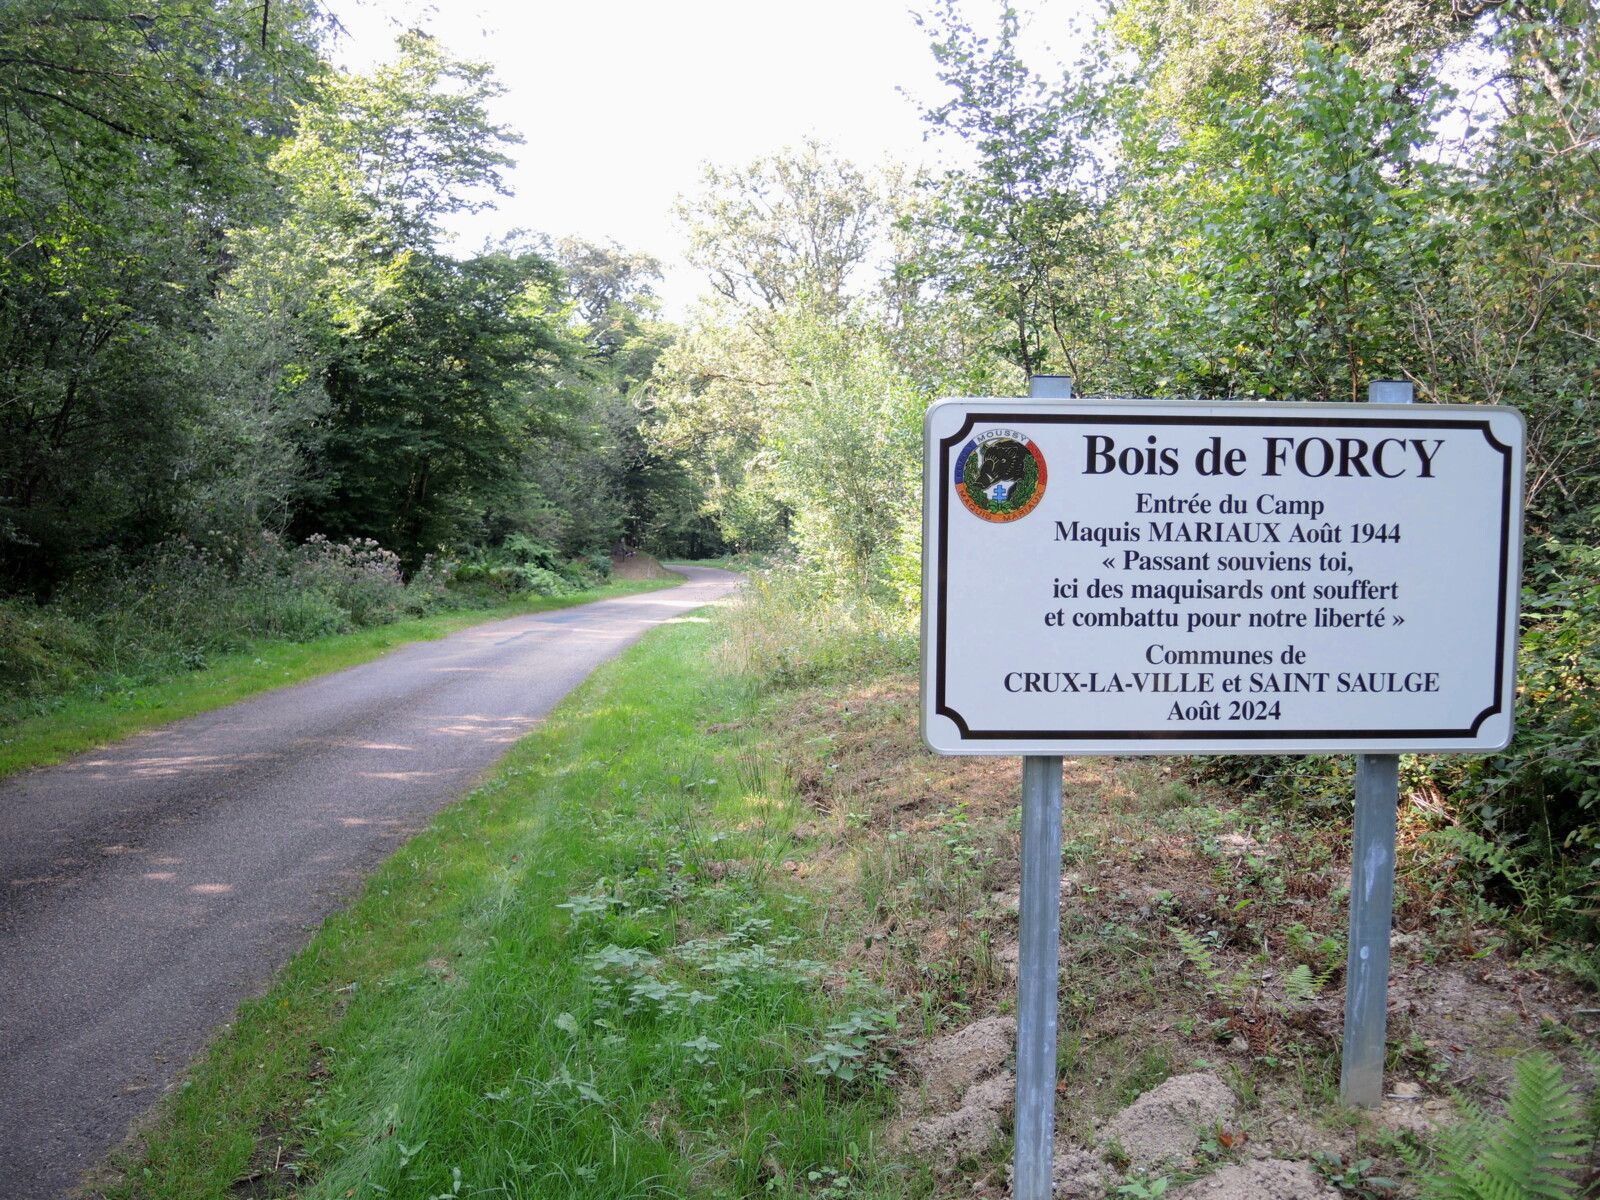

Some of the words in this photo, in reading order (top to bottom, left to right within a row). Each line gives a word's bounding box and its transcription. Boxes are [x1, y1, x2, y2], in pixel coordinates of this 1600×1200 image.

[977, 429, 1028, 443] MOUSSY
[1082, 435, 1178, 475] Bois
[1195, 437, 1246, 476] de
[1262, 437, 1445, 478] FORCY
[959, 490, 992, 520] MAQUIS
[1002, 488, 1044, 521] MARIAUX
[1137, 493, 1211, 513] Entrée
[1220, 494, 1247, 514] du
[1257, 494, 1324, 519] Camp
[1056, 521, 1140, 547] Maquis
[1149, 522, 1280, 542] MARIAUX
[1289, 523, 1341, 543] Août
[1352, 524, 1400, 543] 1944
[1124, 551, 1209, 570] Passant
[1218, 551, 1311, 571] souviens
[1320, 552, 1353, 575] toi,
[1054, 578, 1077, 598] ici
[1087, 579, 1123, 598] des
[1132, 579, 1262, 603] maquisards
[1271, 582, 1306, 599] ont
[1314, 580, 1398, 599] souffert
[1045, 609, 1064, 626] et
[1073, 607, 1178, 627] combattu
[1187, 613, 1241, 632] pour
[1249, 610, 1306, 627] notre
[1315, 607, 1385, 627] liberté
[1146, 645, 1272, 664] Communes
[1281, 645, 1306, 664] de
[1004, 673, 1214, 692] CRUX-LA-VILLE
[1223, 675, 1241, 692] et
[1250, 673, 1329, 692] SAINT
[1337, 673, 1439, 692] SAULGE
[1167, 700, 1220, 720] Août
[1229, 701, 1281, 720] 2024
